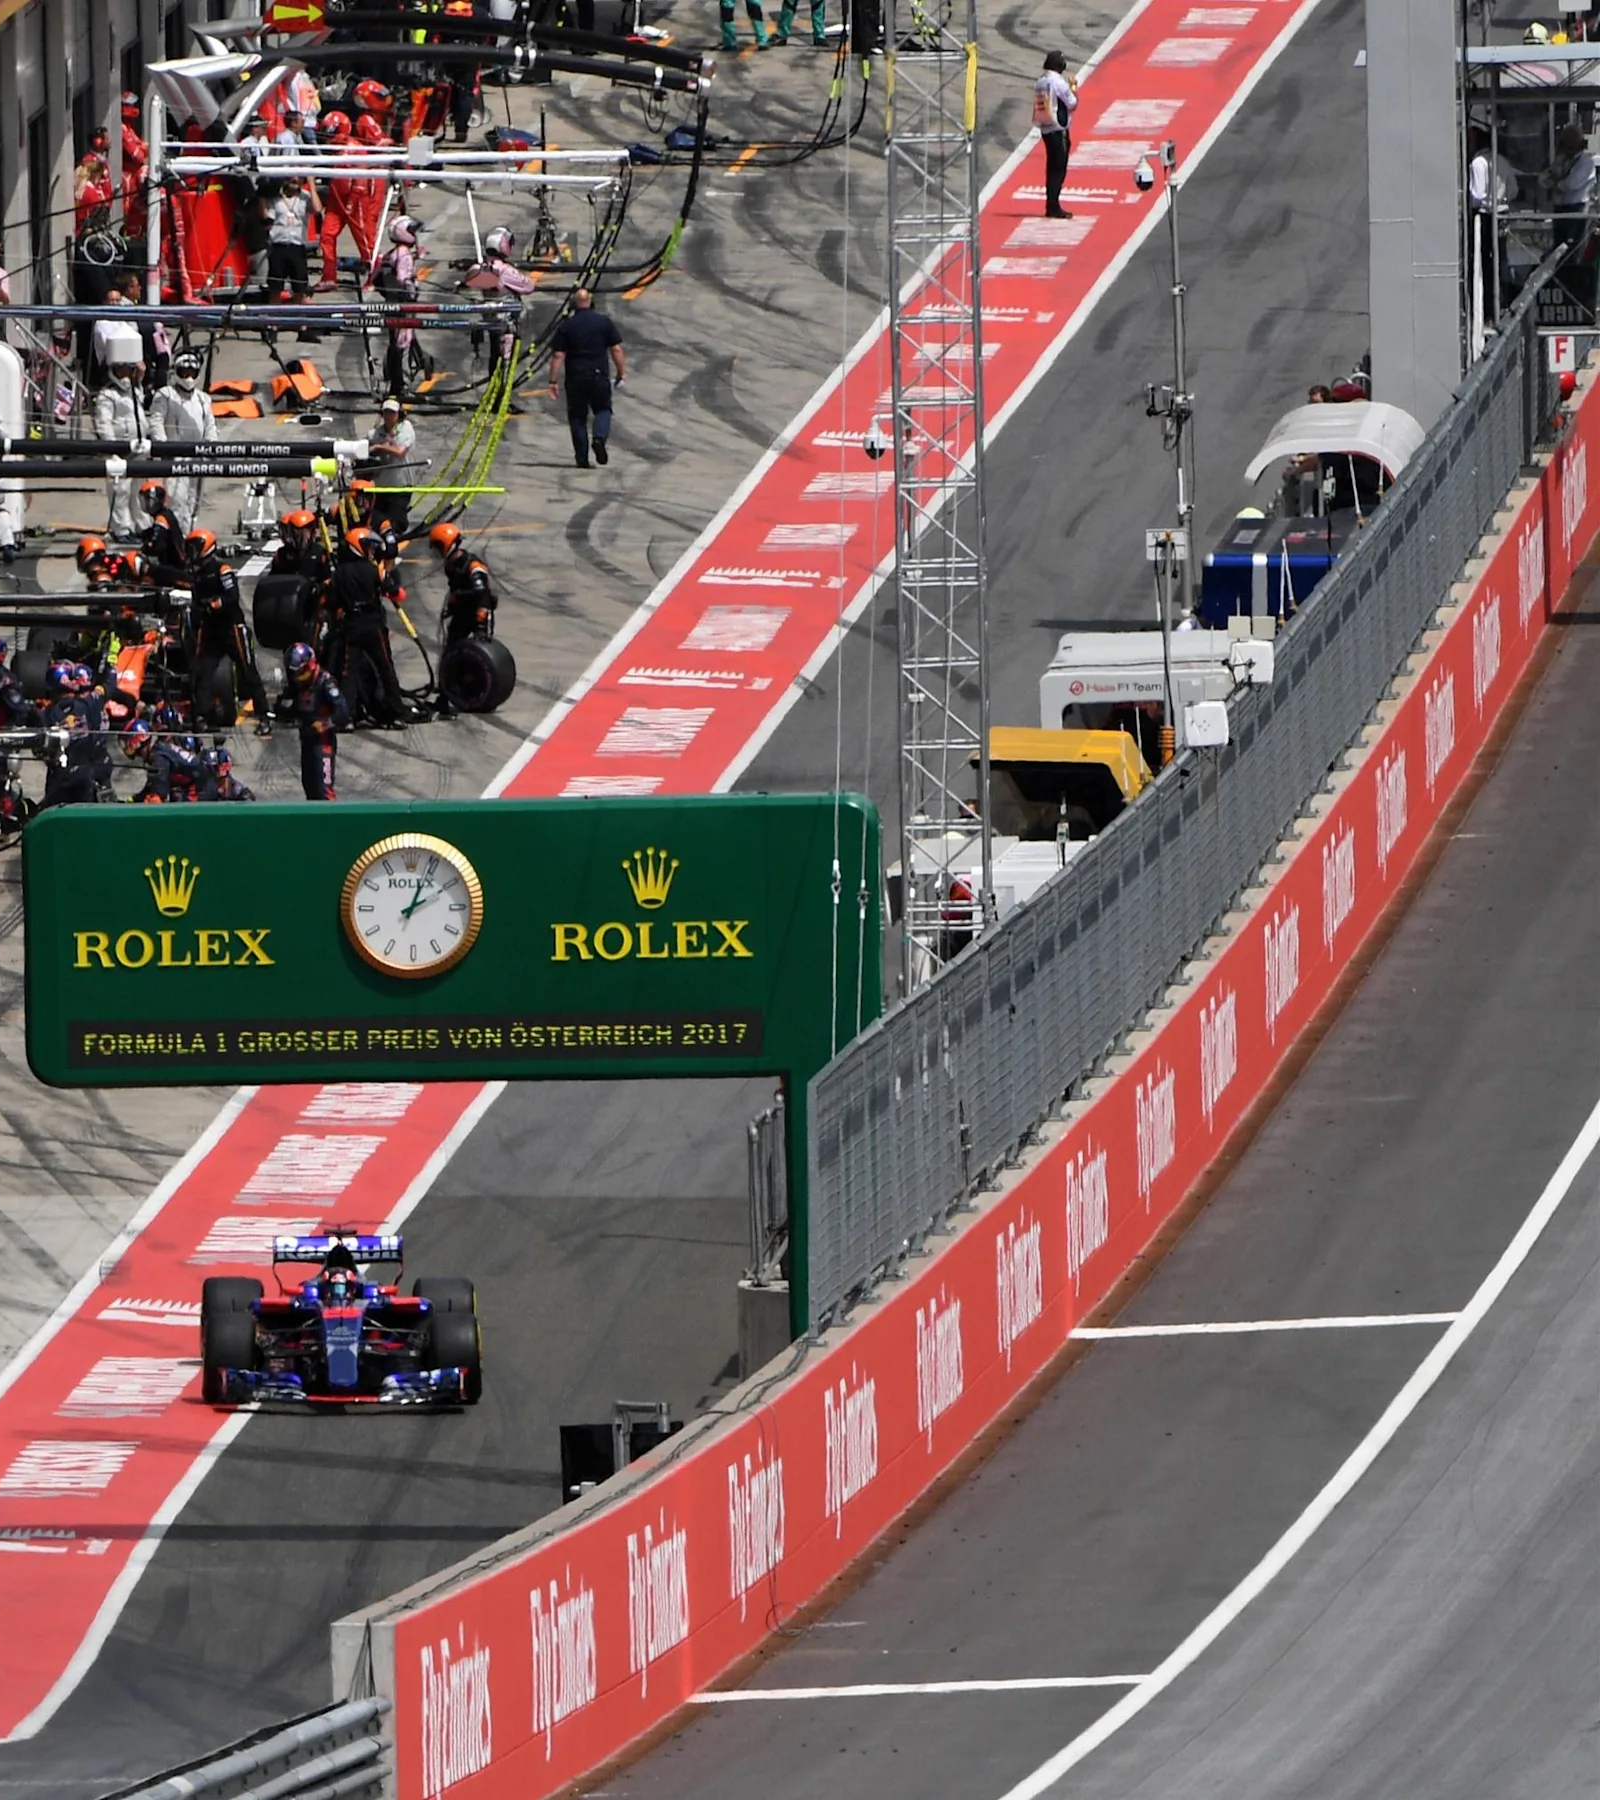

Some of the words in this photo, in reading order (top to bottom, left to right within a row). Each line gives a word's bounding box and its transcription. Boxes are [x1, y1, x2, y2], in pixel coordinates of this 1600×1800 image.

[1555, 338, 1568, 364] F
[73, 929, 276, 968] ROLEX
[388, 876, 435, 889] ROLEX
[550, 920, 754, 961] ROLEX
[83, 1032, 207, 1055] FORMULA
[216, 1032, 228, 1052] 1
[238, 1030, 358, 1053] GROSSER
[367, 1028, 440, 1050] PREIS
[449, 1028, 502, 1048] VON
[510, 1022, 673, 1047] ÖSTERREICH
[681, 1023, 748, 1045] 2017
[916, 1312, 931, 1453] Fly
[930, 1283, 963, 1420] Emirates
[997, 1230, 1011, 1372] Fly
[1010, 1206, 1042, 1339] Emirates
[728, 1462, 746, 1622] Fly
[745, 1438, 785, 1585] Emirates
[824, 1387, 841, 1539] Fly
[839, 1361, 877, 1504] Emirates
[530, 1593, 551, 1761] Fly
[549, 1564, 596, 1723] Emirates
[627, 1536, 647, 1698] Fly
[645, 1507, 689, 1661] Emirates
[421, 1645, 443, 1800] Fly
[441, 1620, 491, 1788] Emirates
